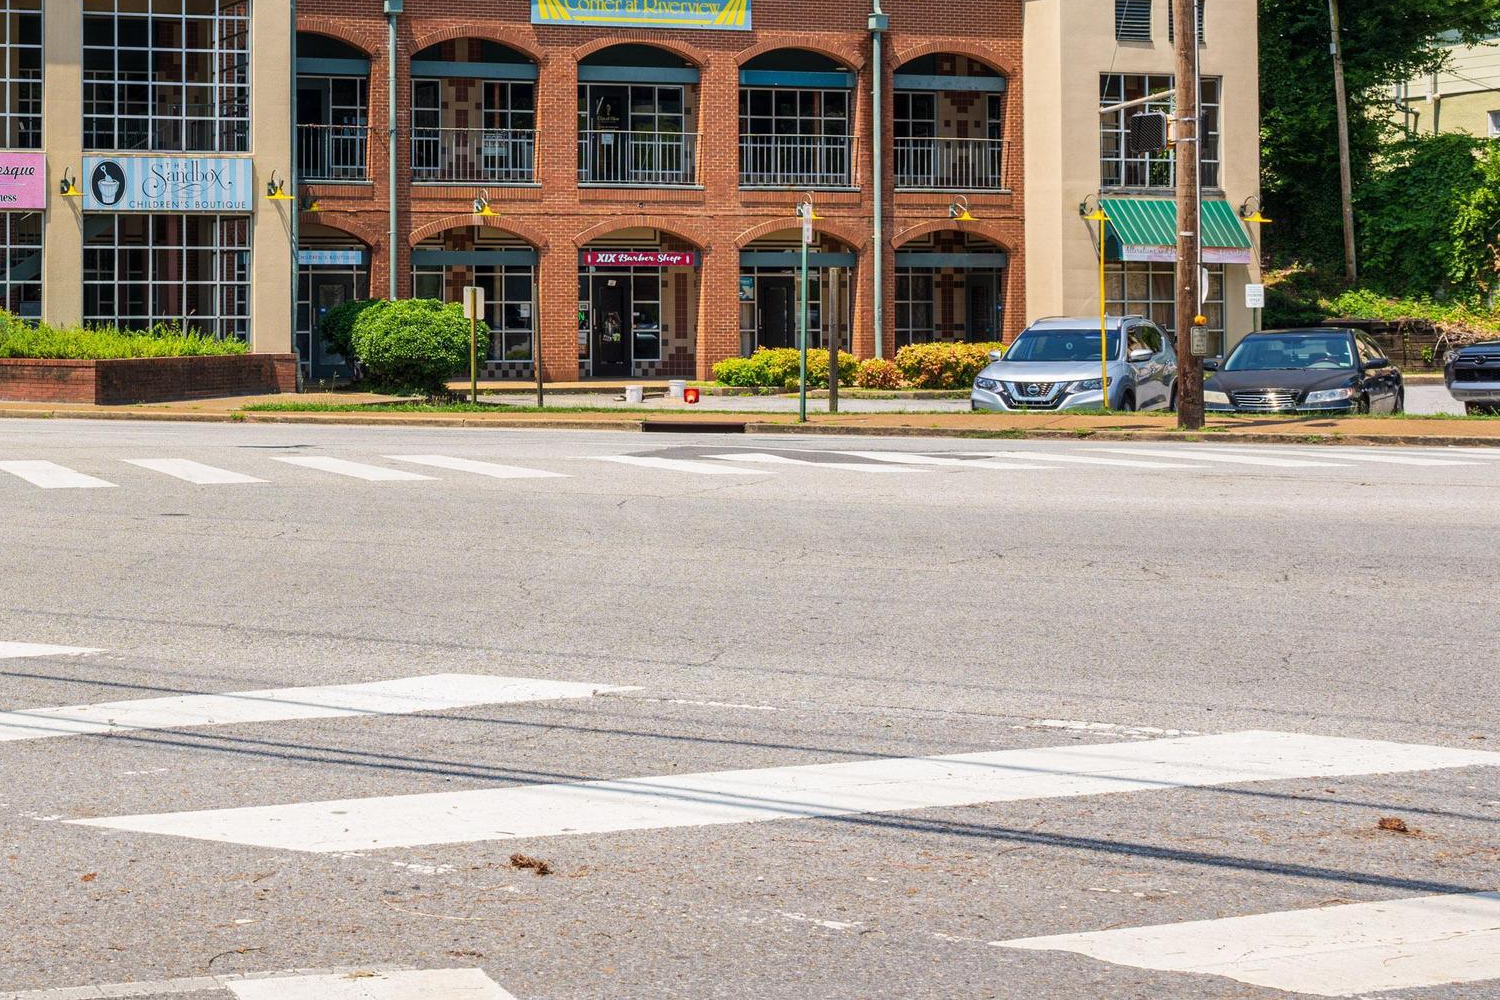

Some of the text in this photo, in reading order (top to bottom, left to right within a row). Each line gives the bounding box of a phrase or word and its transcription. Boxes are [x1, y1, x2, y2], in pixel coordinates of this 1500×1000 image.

[142, 160, 232, 198] Sandbox
[128, 200, 247, 209] CHILDREN'S BOUTIQUE
[596, 253, 682, 263] XIX Barber Shop
